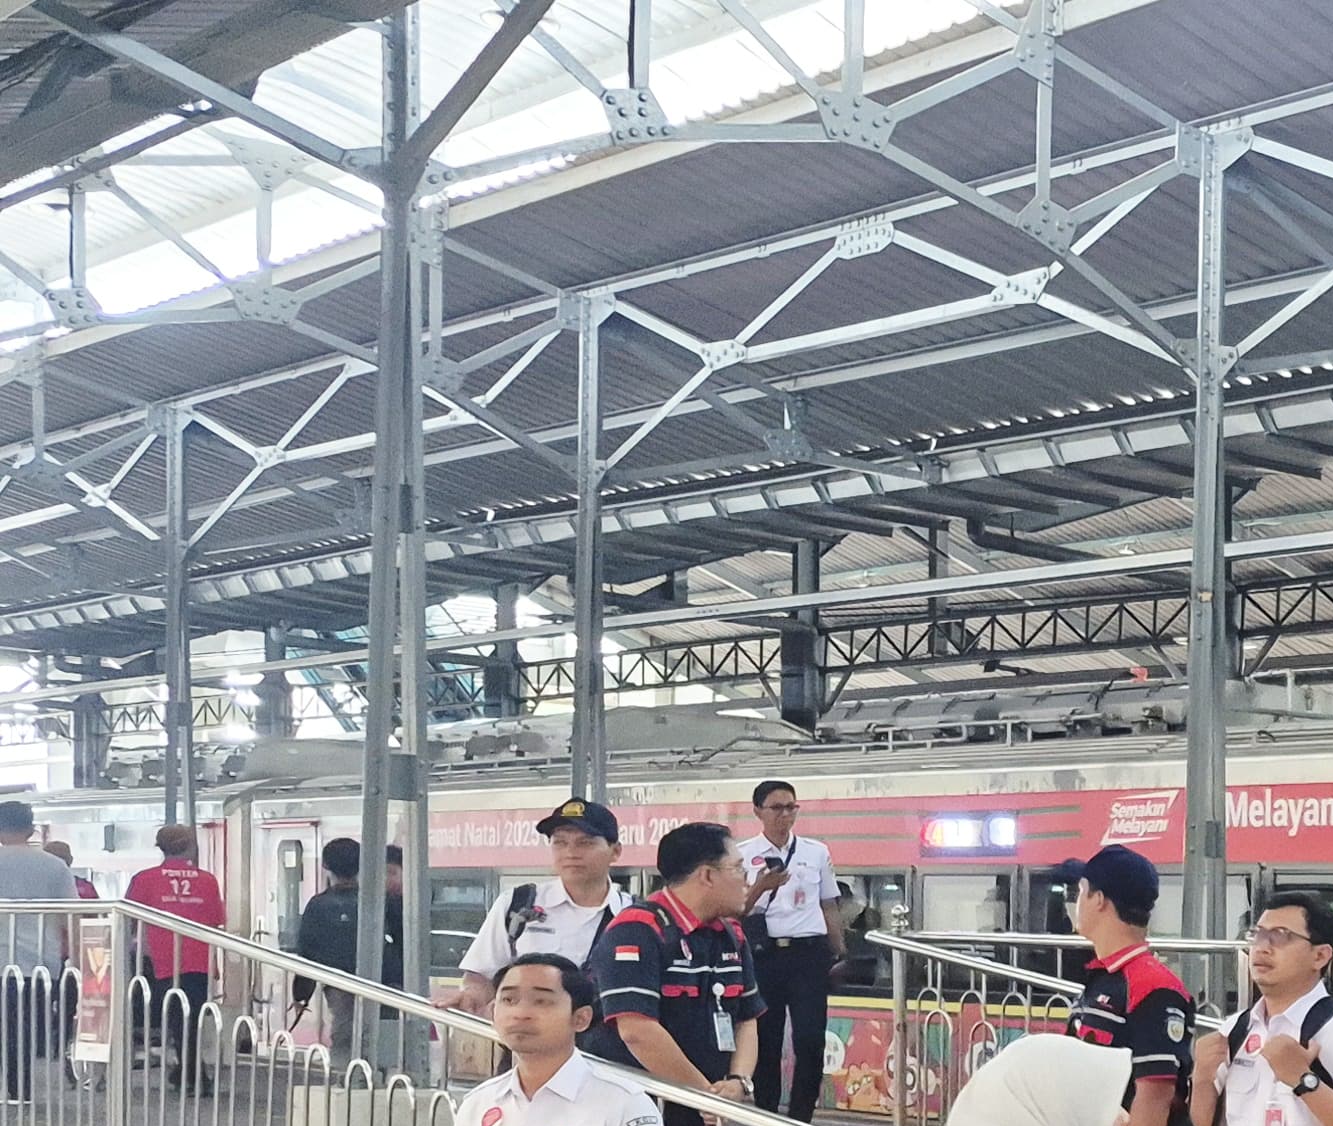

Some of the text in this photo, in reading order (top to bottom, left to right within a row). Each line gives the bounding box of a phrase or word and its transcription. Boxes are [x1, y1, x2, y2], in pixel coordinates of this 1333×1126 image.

[1110, 800, 1166, 819] Semakin
[428, 822, 461, 848] amat
[464, 820, 500, 847] Natal
[617, 823, 644, 847] aru
[1111, 818, 1169, 837] Melayani
[169, 879, 191, 896] 12
